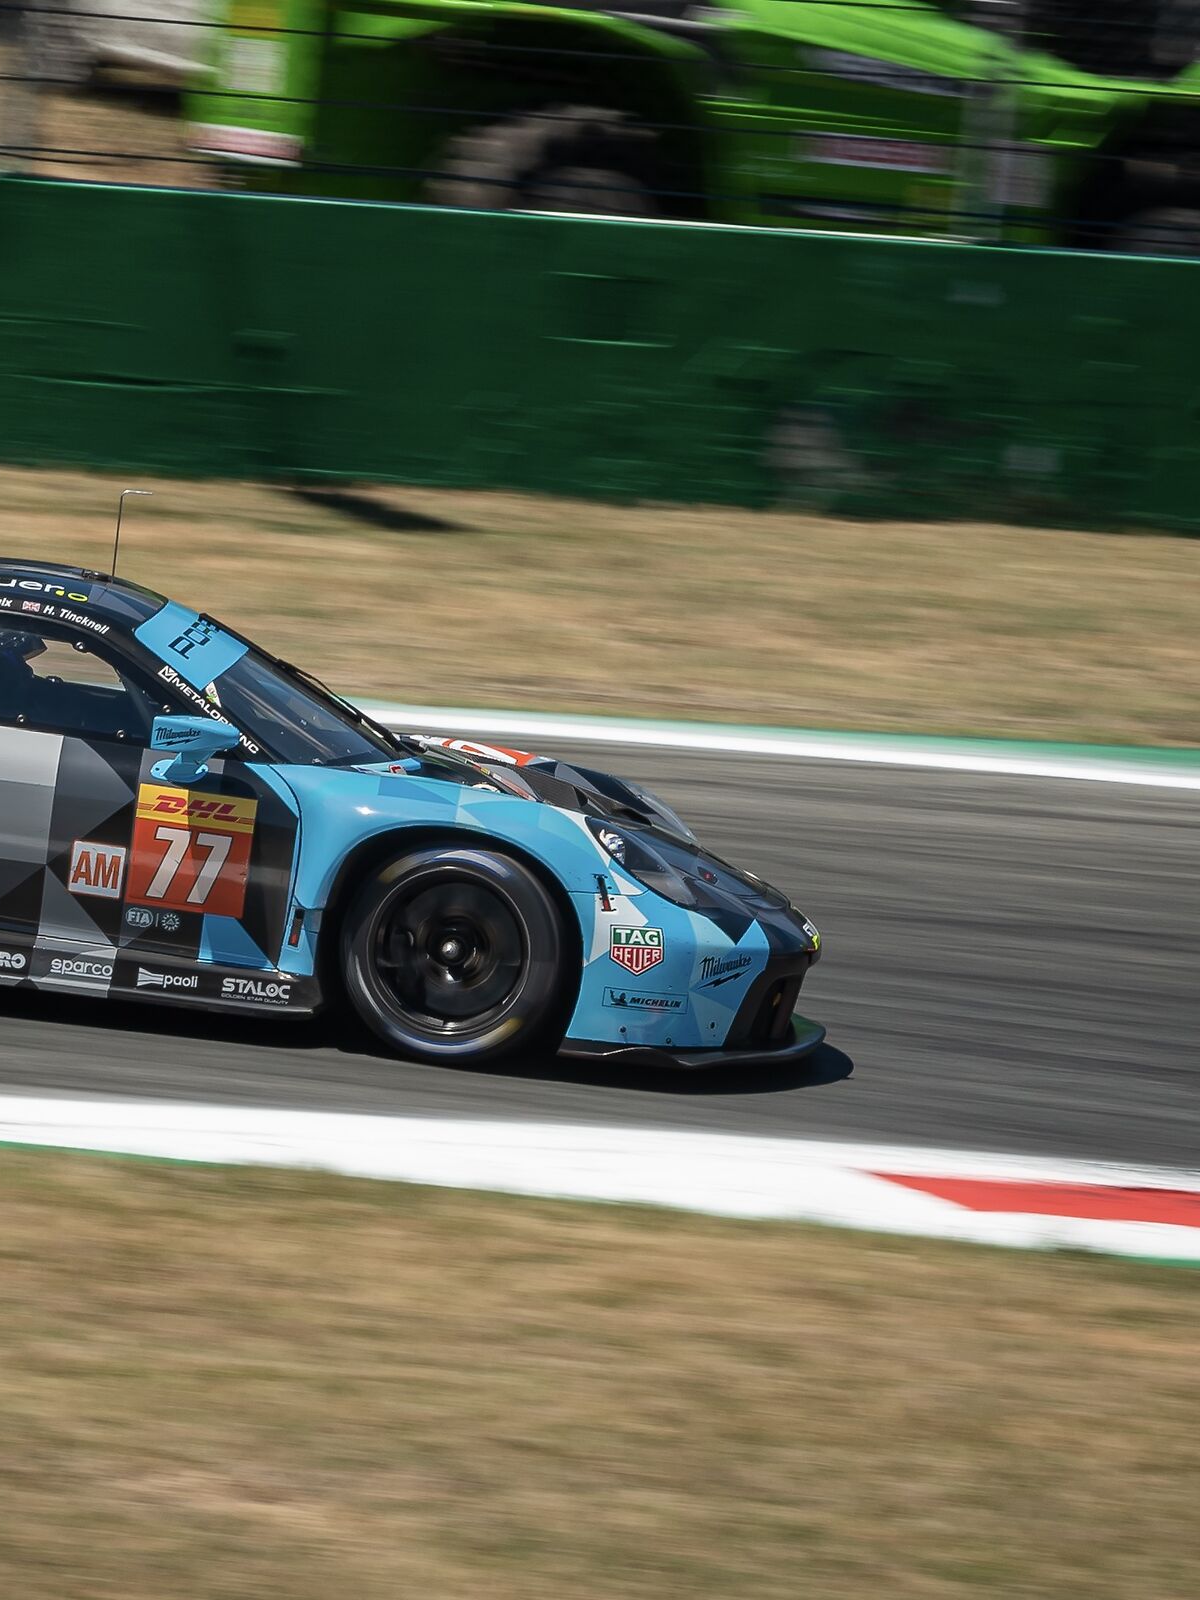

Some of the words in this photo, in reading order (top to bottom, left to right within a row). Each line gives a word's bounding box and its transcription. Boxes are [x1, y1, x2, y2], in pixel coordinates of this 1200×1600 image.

[43, 605, 55, 616] H.
[153, 795, 240, 823] DHL
[71, 850, 121, 890] AM
[146, 826, 233, 905] 77
[127, 911, 150, 925] FIA
[615, 928, 659, 946] TAG
[50, 958, 113, 978] sparco
[613, 947, 662, 972] HEUER
[700, 954, 752, 981] Milwaukee
[163, 974, 198, 988] paoli
[222, 977, 291, 1000] STALOC
[629, 997, 682, 1009] MICHELIN
